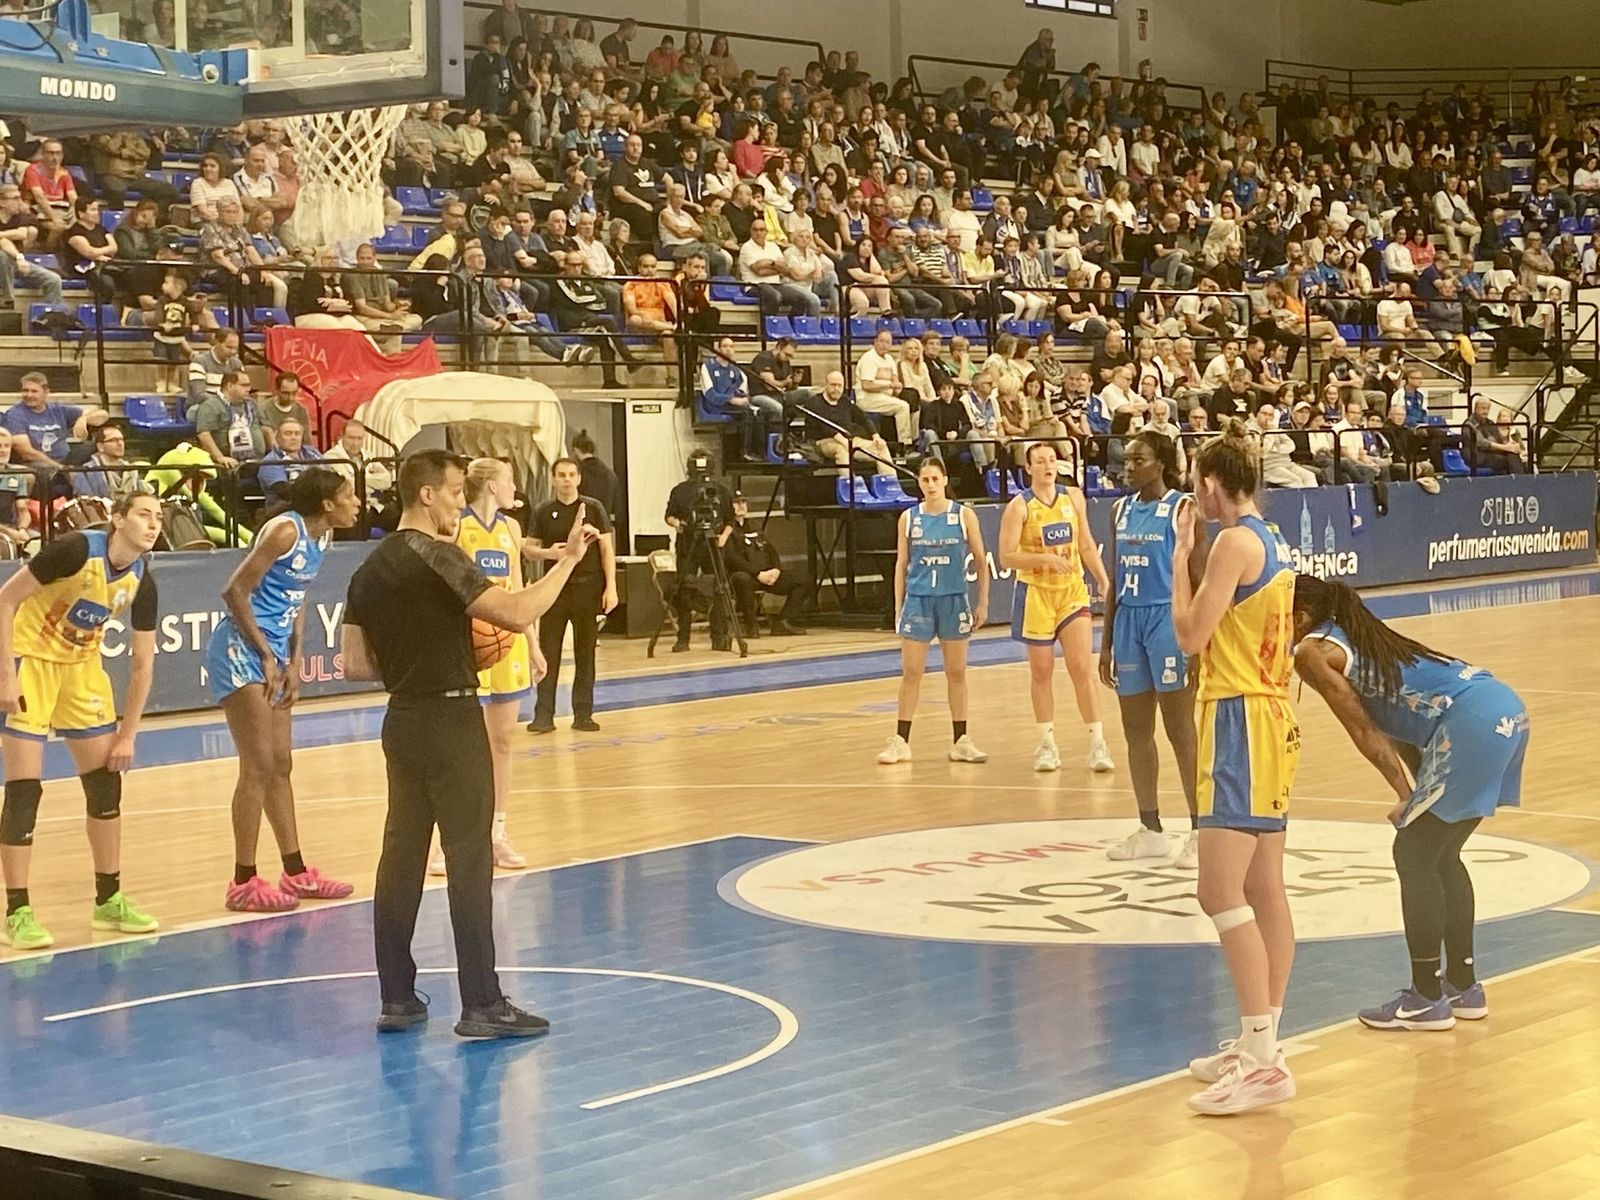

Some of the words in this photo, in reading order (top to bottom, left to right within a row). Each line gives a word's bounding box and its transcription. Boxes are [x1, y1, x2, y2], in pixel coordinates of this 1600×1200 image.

[40, 76, 116, 101] MONDO
[1428, 525, 1589, 570] perfumeriasavenida.com
[316, 602, 344, 649] Y
